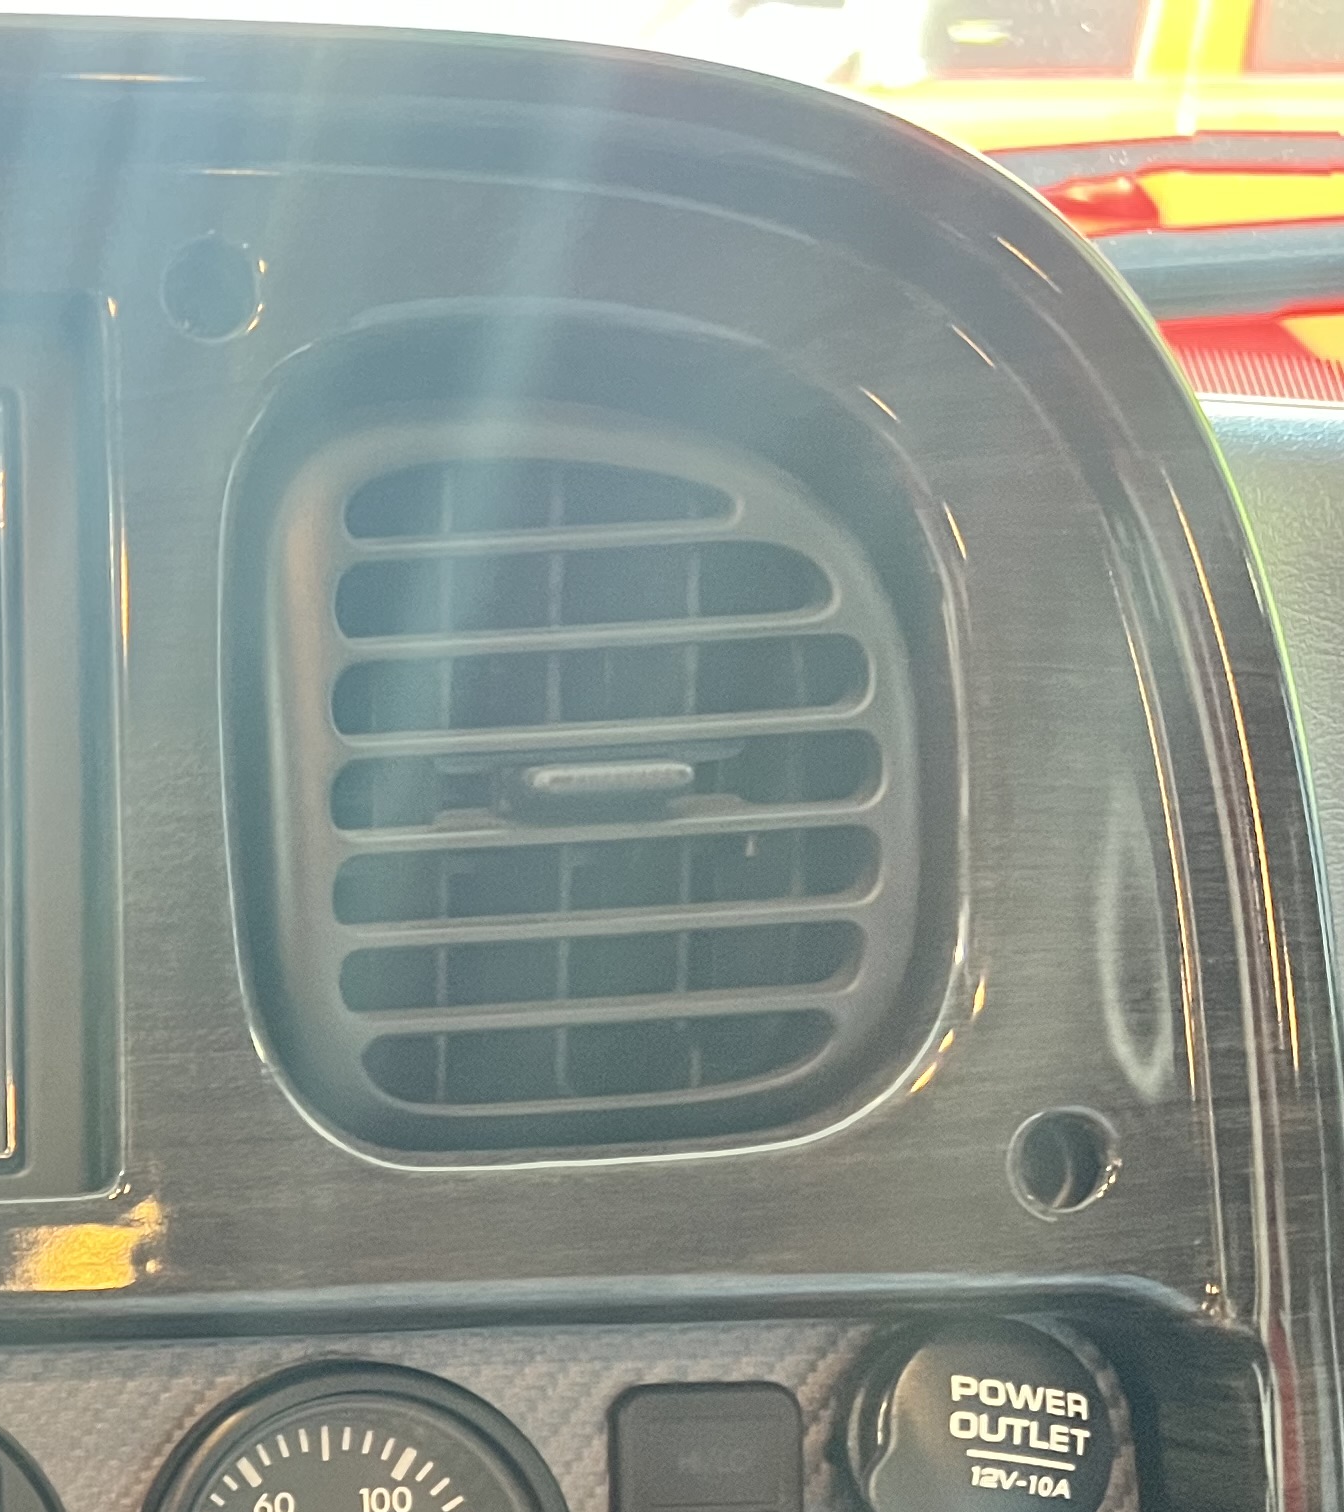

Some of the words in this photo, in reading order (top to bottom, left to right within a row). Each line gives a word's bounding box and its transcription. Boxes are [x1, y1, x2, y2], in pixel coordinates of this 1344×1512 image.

[950, 1374, 1089, 1421] POWER
[949, 1411, 1091, 1456] OUTLET
[970, 1466, 1072, 1500] 12V-10A
